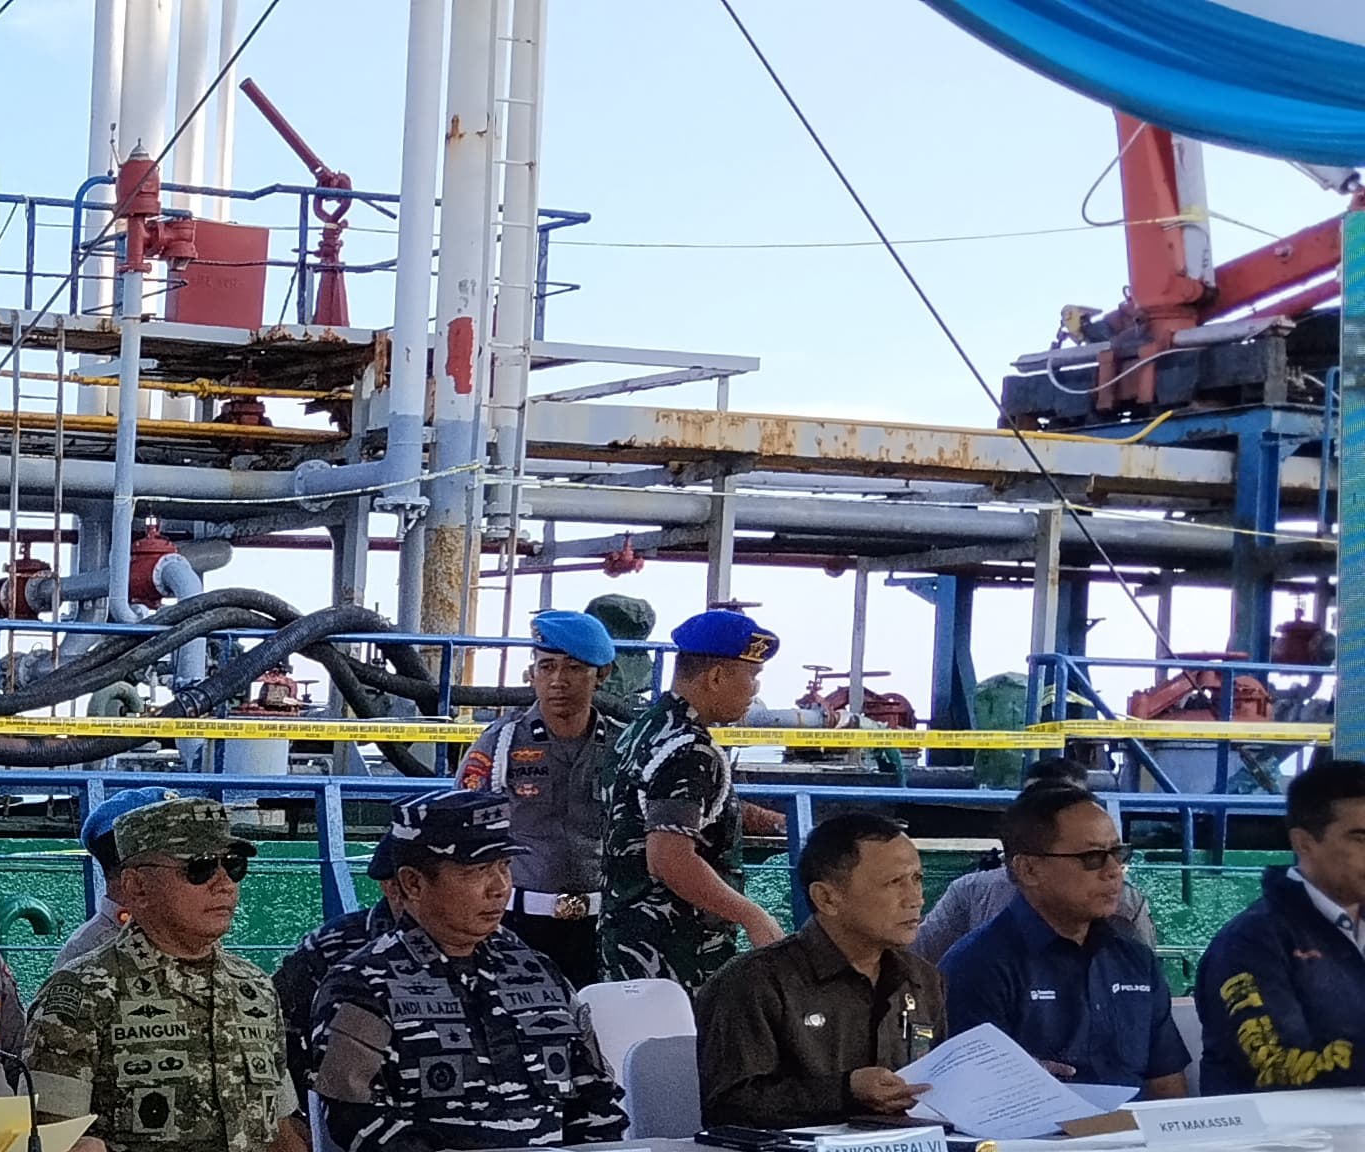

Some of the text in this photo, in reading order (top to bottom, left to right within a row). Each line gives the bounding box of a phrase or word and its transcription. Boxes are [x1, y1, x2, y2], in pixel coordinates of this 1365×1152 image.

[506, 991, 562, 1005] TNI AL
[395, 1001, 418, 1017] ANDI
[114, 1024, 187, 1041] BANGUN
[238, 1026, 262, 1039] TNI
[1159, 1116, 1244, 1132] KPT MAKASSAR
